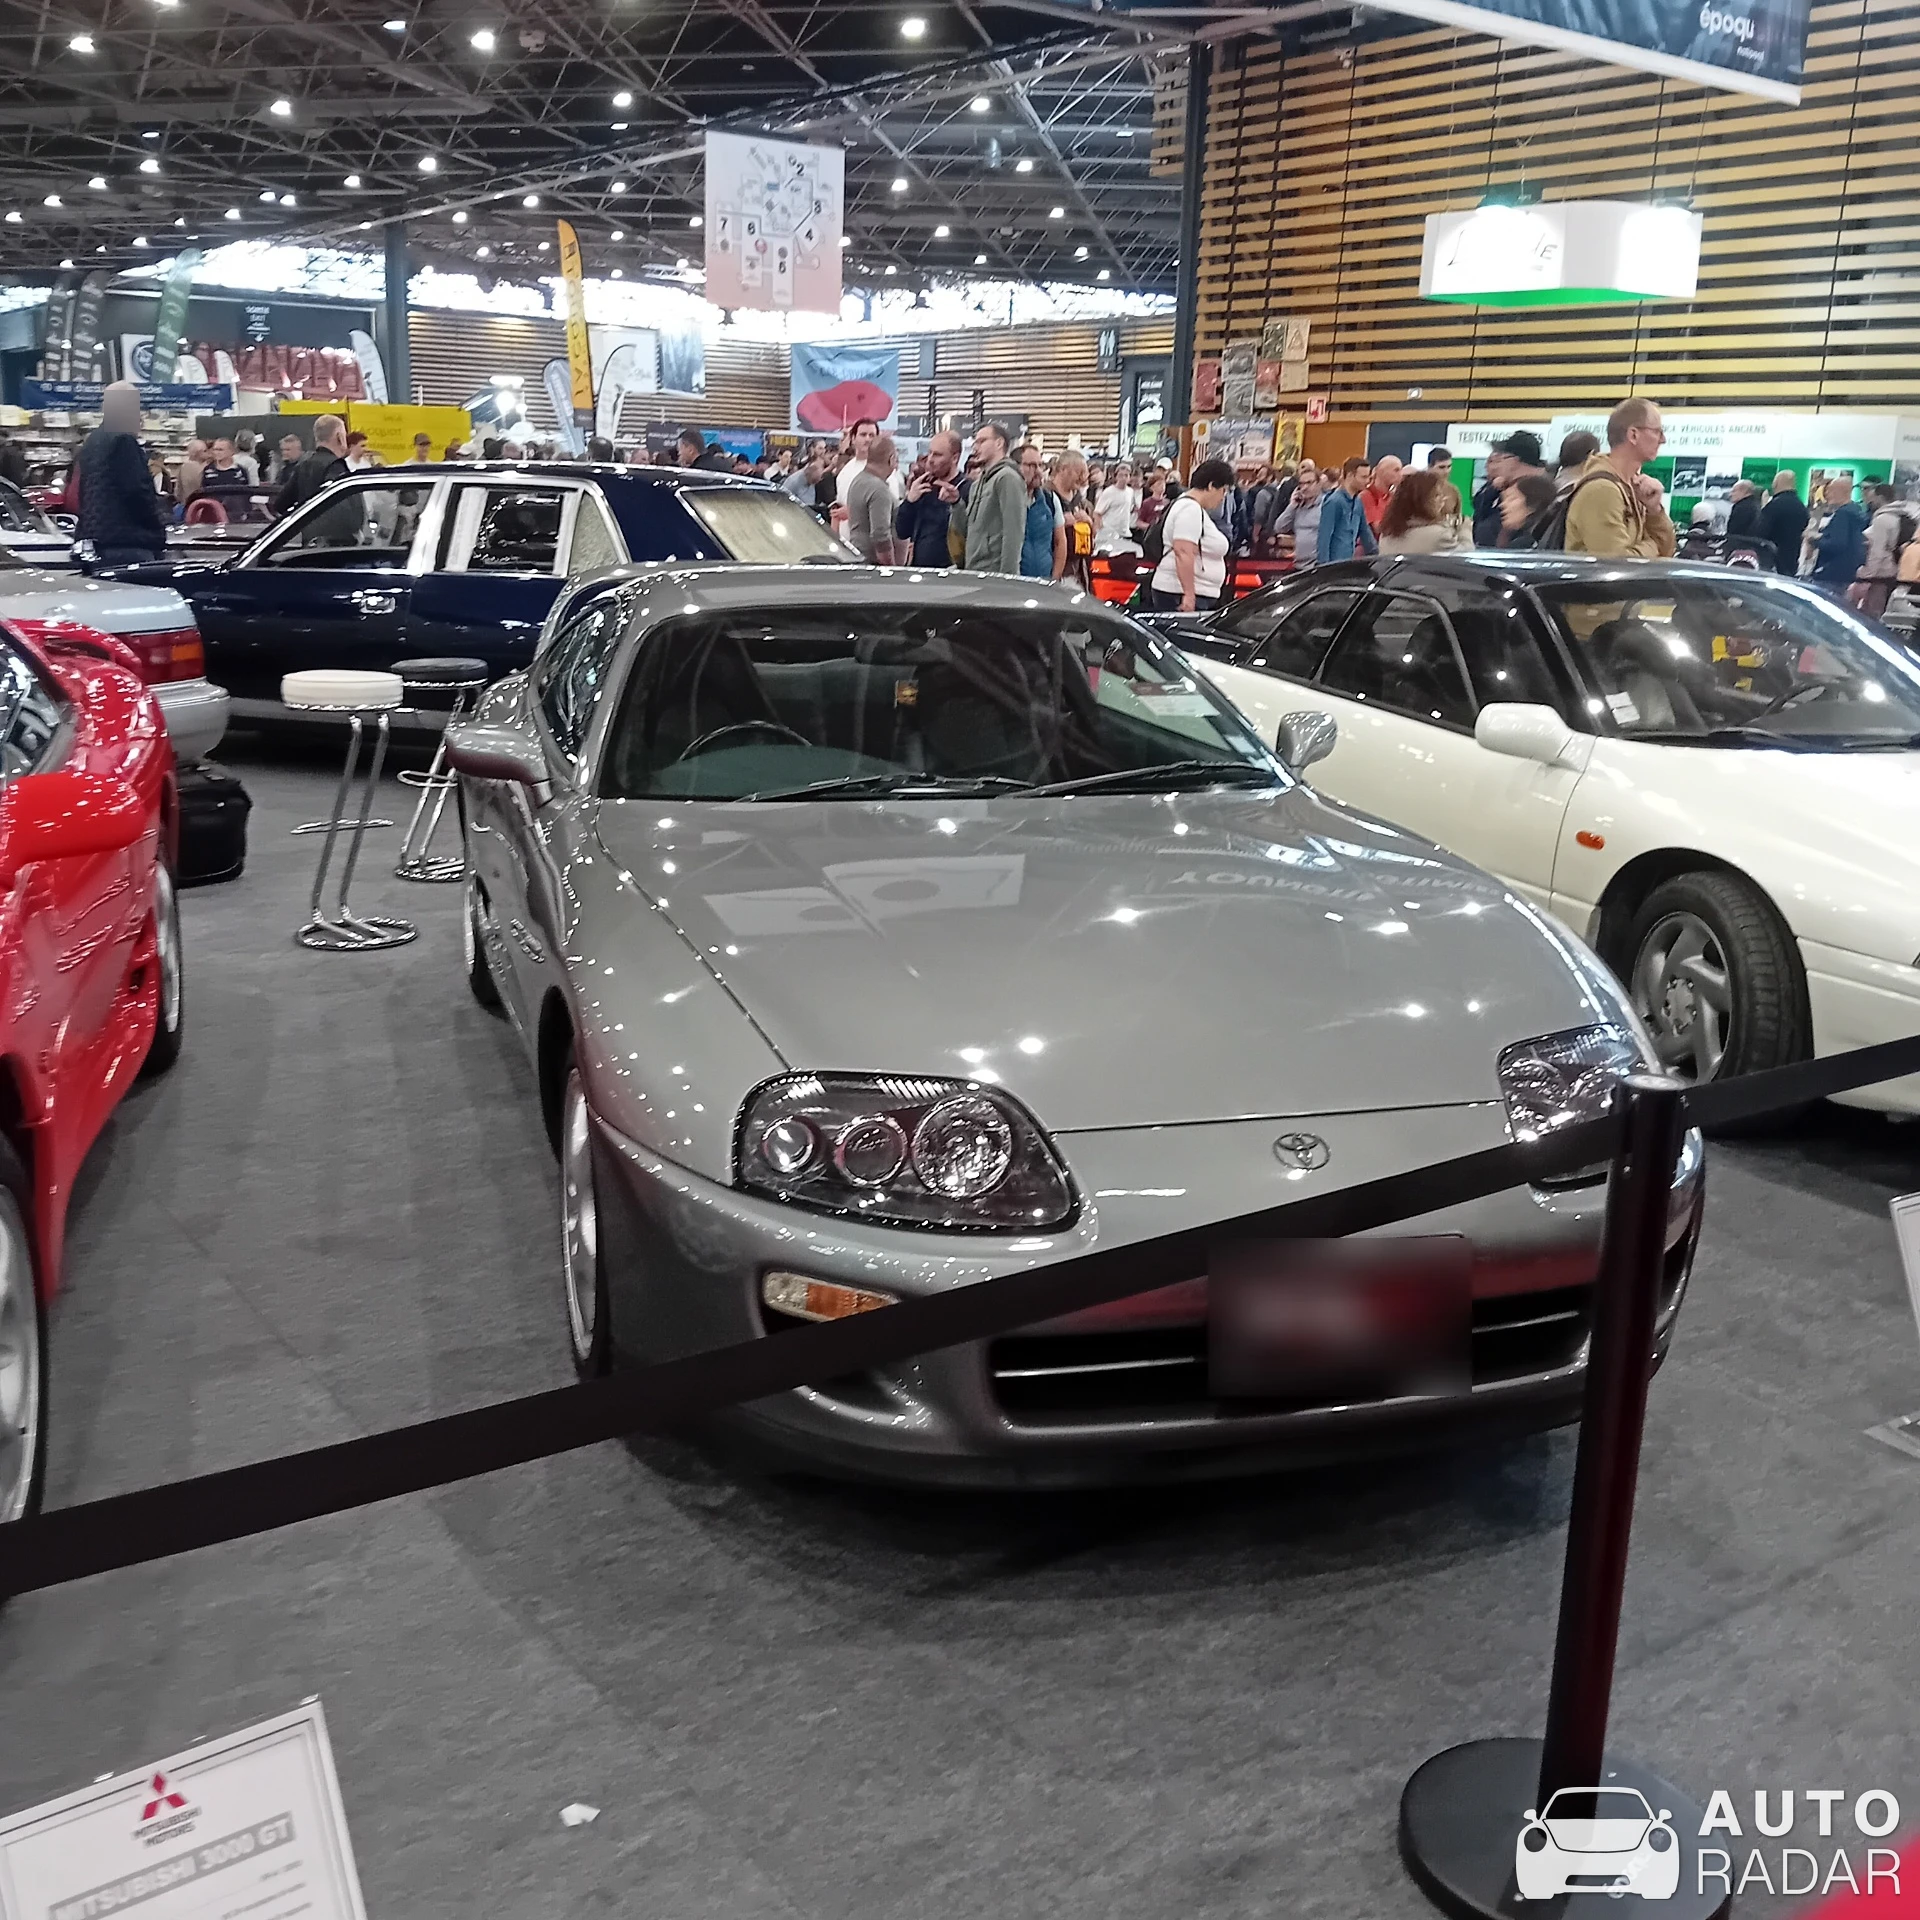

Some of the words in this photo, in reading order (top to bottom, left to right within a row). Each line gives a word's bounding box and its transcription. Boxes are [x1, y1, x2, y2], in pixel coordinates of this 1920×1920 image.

[720, 216, 729, 231] 7
[805, 227, 814, 242] 4
[1728, 423, 1767, 435] ANCIENS
[1459, 431, 1493, 443] TESTEZ
[133, 1807, 202, 1839] MITSUBISHI
[146, 1820, 196, 1847] MOTORS
[201, 1832, 256, 1871] 3000
[257, 1818, 293, 1847] GT
